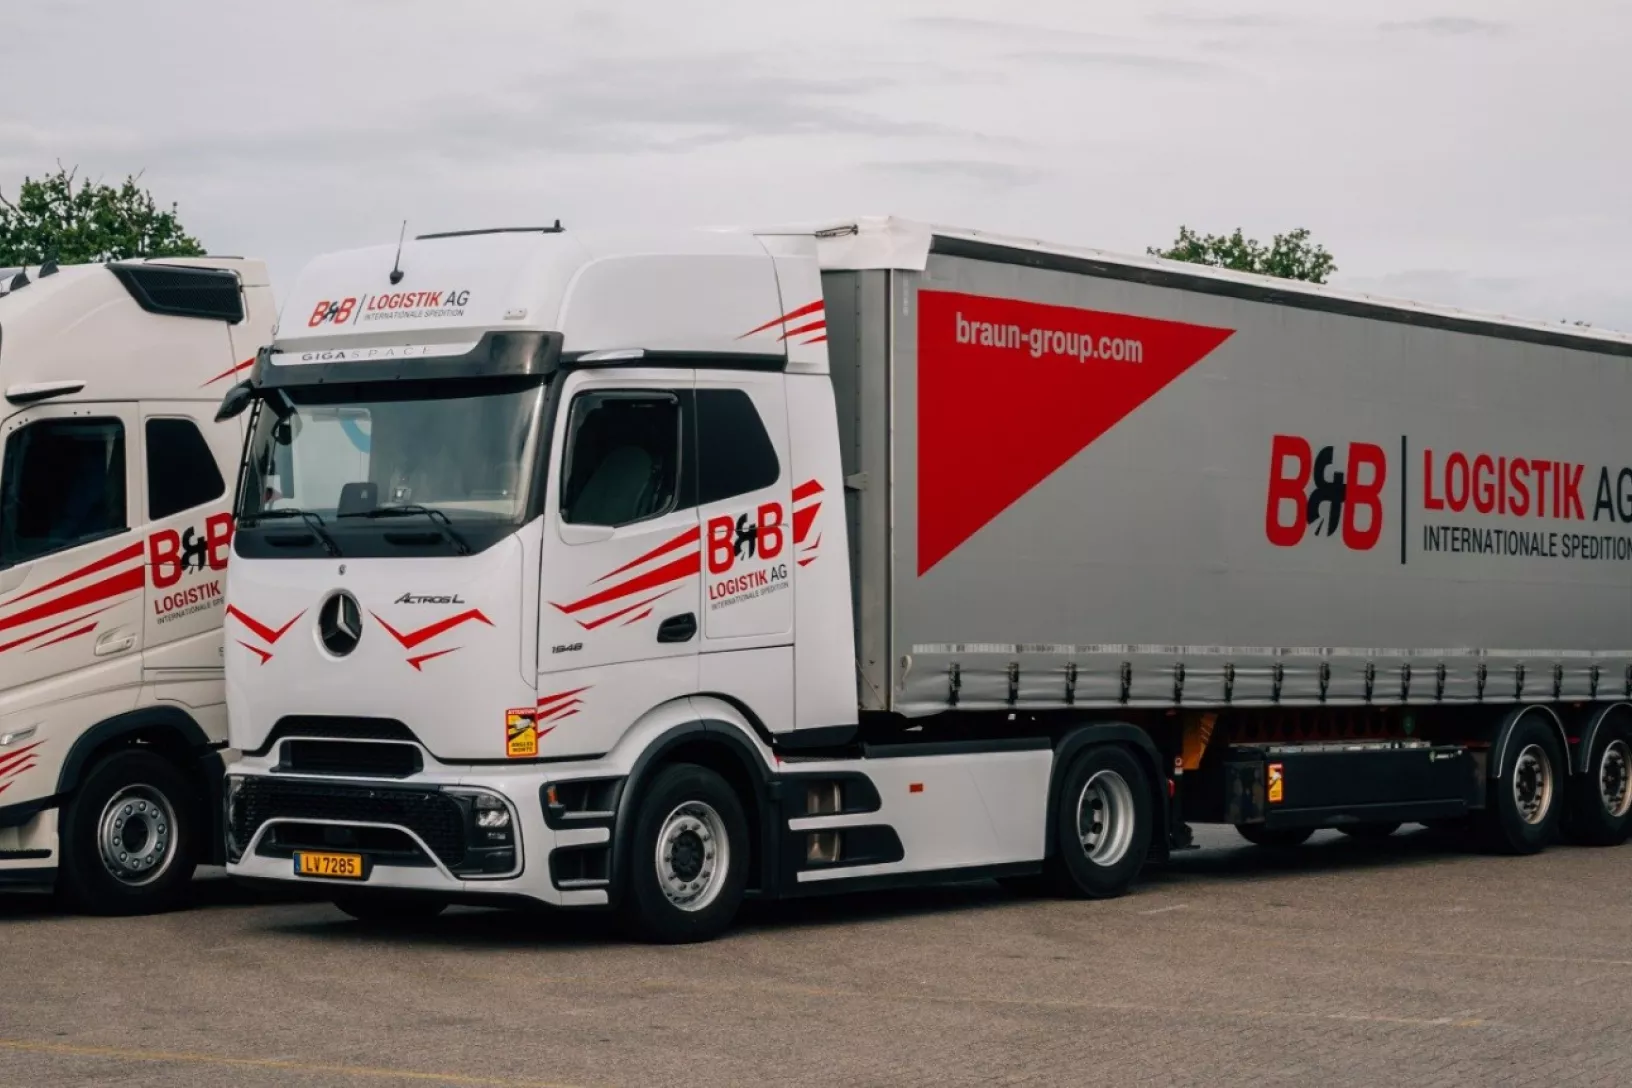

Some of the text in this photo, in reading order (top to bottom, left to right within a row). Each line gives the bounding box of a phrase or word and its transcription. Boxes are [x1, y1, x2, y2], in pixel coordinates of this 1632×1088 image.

[308, 297, 357, 328] B&B
[364, 308, 465, 321] INTERNATIONALE SPEDITION
[367, 289, 471, 311] LOGISTIK AG
[955, 311, 1144, 364] braun-group.com
[1265, 434, 1388, 551] B&B
[1424, 449, 1632, 524] LOGISTIK AG
[149, 512, 234, 589] B&B
[707, 502, 784, 575] B&B
[1423, 525, 1558, 558] INTERNATIONALE
[154, 579, 222, 615] LOGISTIK
[709, 563, 788, 601] LOGISTIK AG
[711, 581, 789, 611] INTERNATIONALE SPEDITION
[157, 601, 212, 626] INTERNATIONALE
